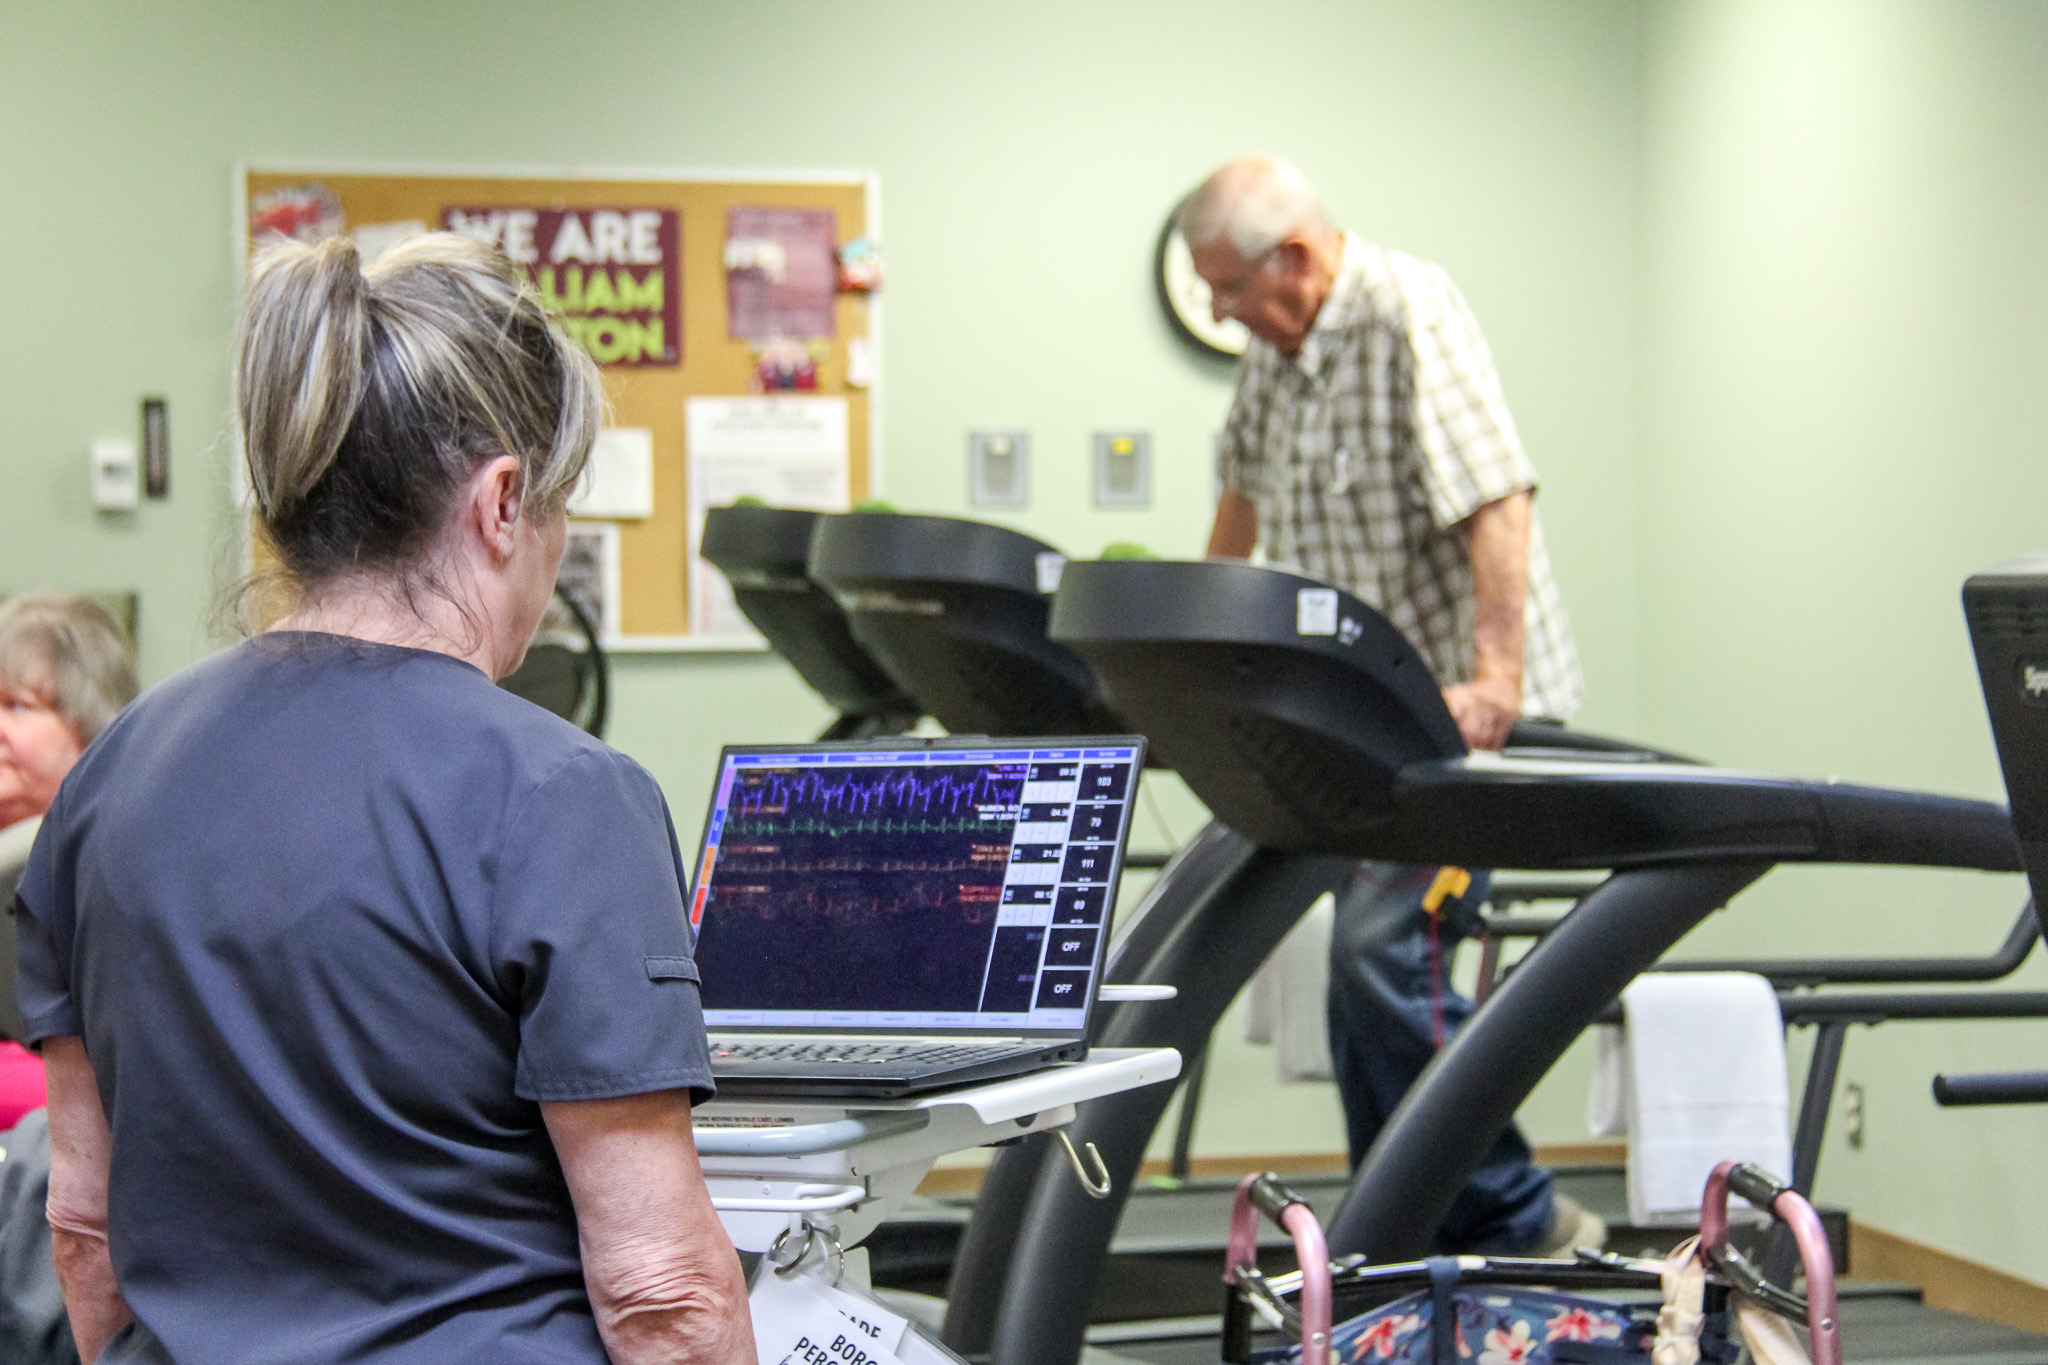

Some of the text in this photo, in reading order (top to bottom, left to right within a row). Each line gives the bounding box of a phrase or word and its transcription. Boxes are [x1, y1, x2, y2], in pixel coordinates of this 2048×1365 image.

[449, 210, 662, 263] WE ARE
[517, 266, 664, 313] LIAM
[560, 316, 664, 362] TON
[1061, 942, 1081, 952] OFF
[1053, 984, 1073, 994] OFF
